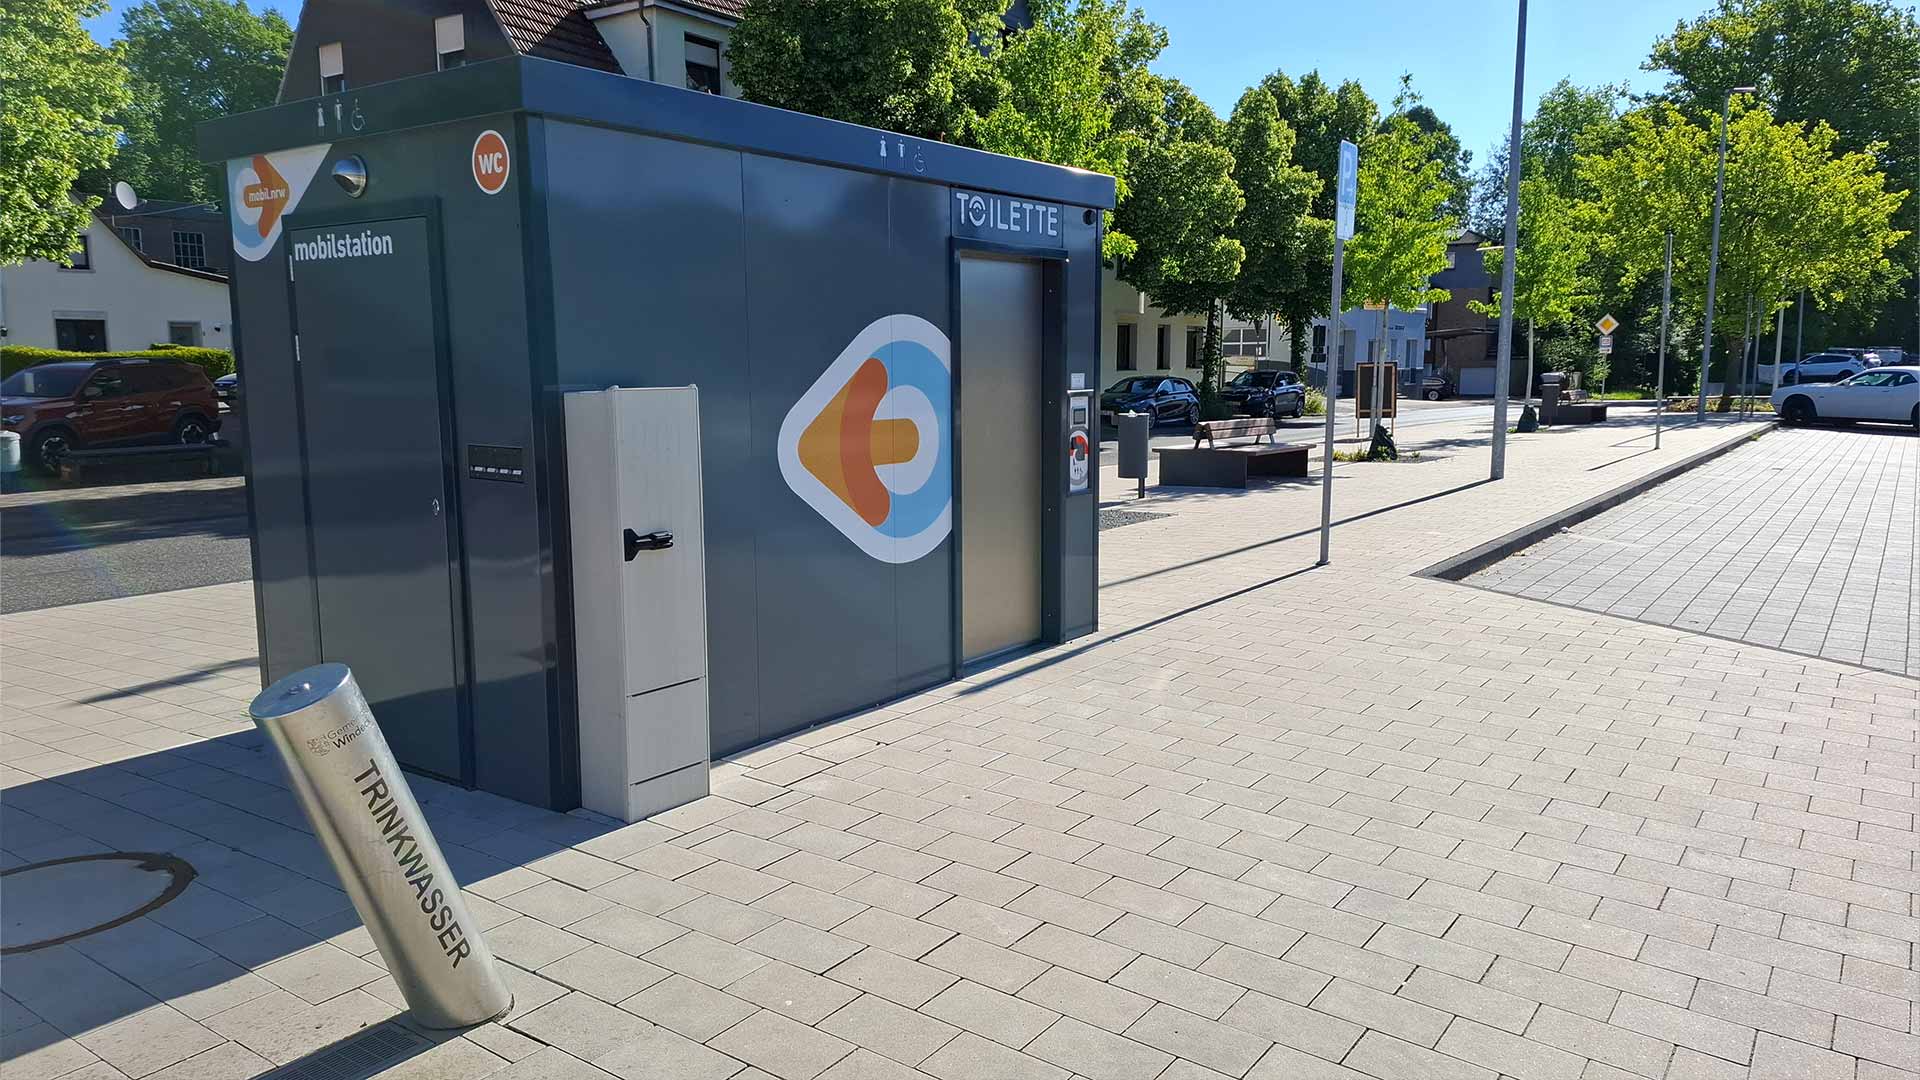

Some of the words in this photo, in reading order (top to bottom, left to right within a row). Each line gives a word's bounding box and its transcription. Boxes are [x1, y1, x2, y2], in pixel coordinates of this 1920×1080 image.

[478, 151, 503, 175] WC
[248, 187, 286, 202] mobil.nrw
[956, 192, 1058, 236] TOILETTE
[294, 230, 393, 261] mobilstation
[353, 758, 472, 969] TRINKWASSER
